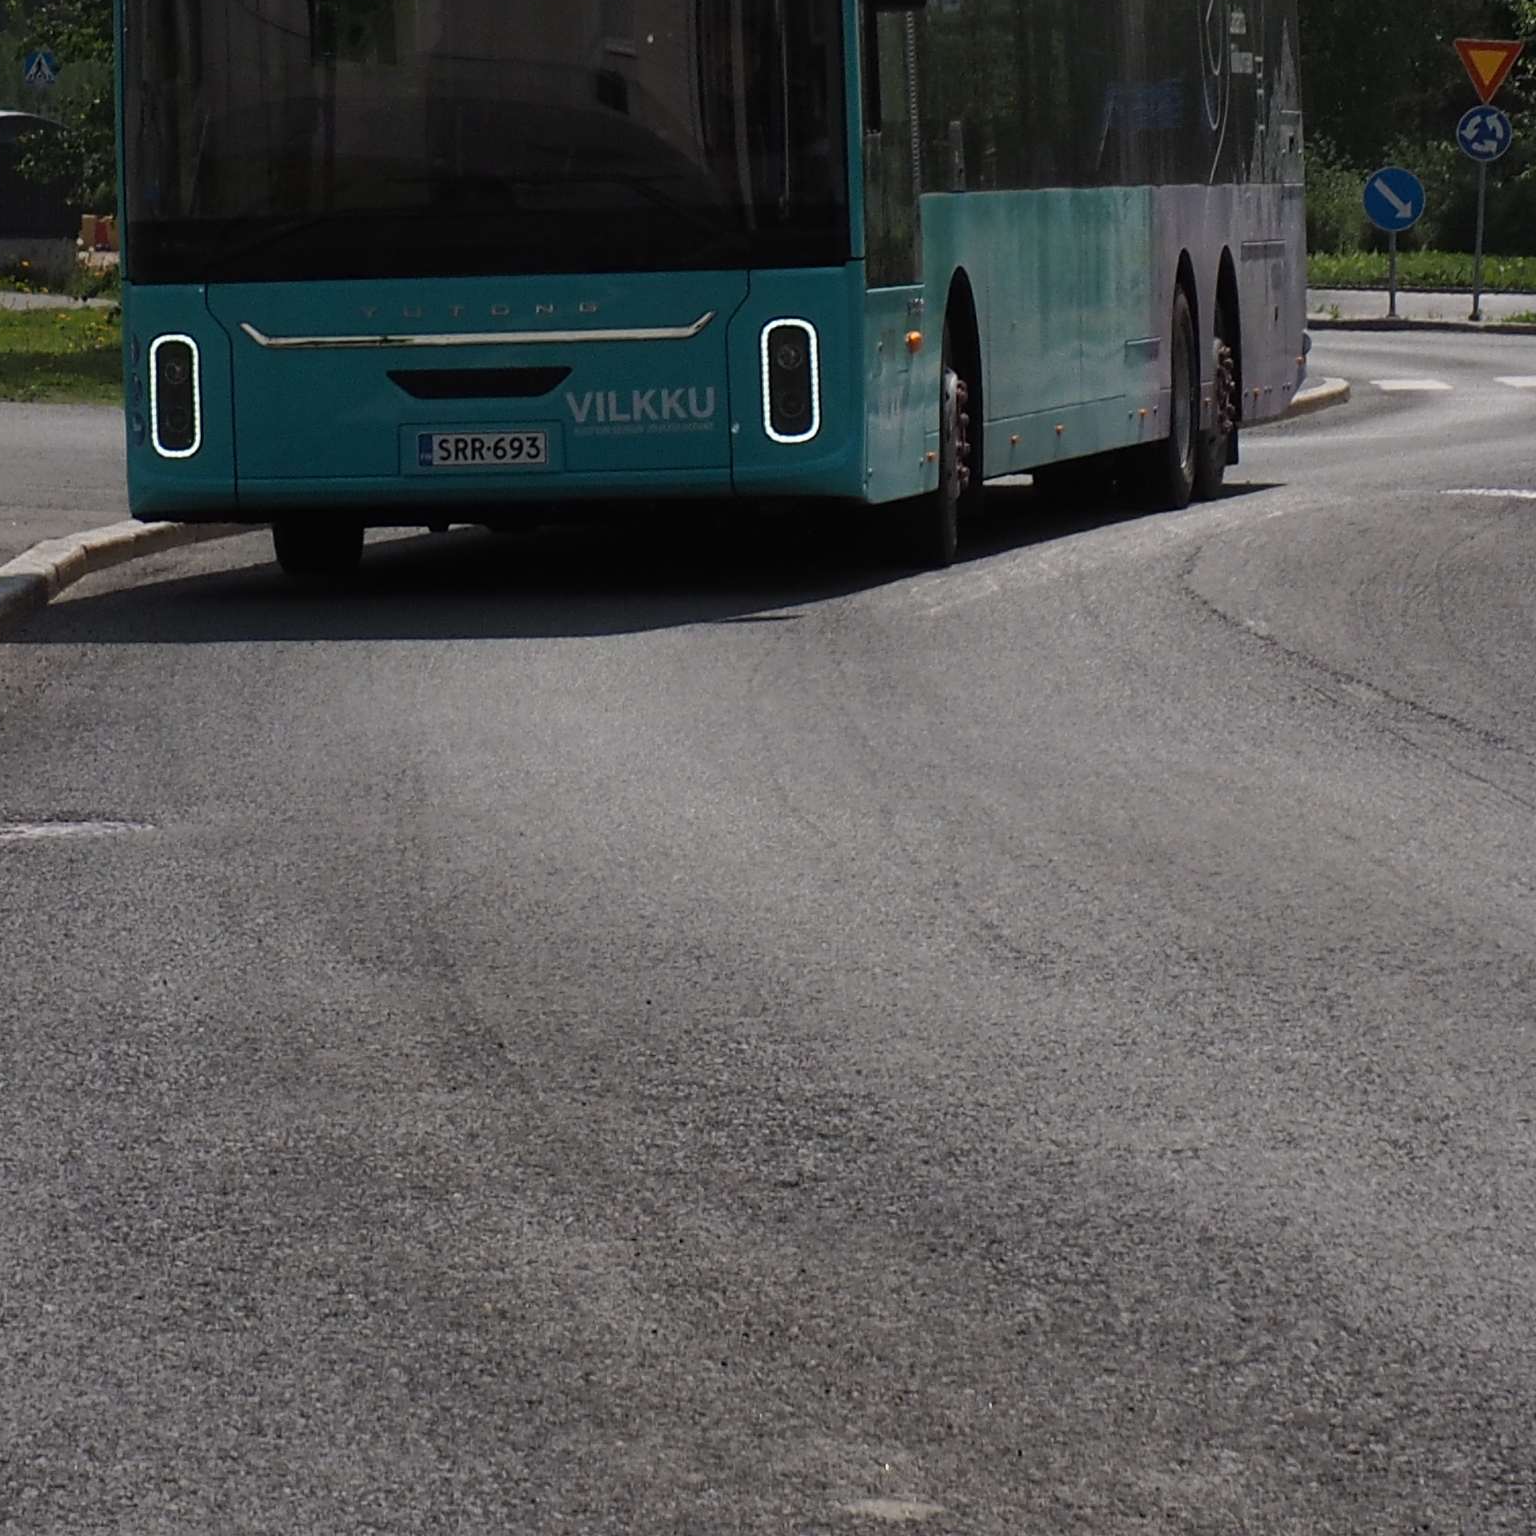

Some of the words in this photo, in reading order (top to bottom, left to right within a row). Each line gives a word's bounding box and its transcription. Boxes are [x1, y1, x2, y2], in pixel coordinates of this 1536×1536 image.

[362, 301, 599, 319] YUTONG
[565, 386, 716, 423] VILKKU
[438, 436, 542, 462] SRR-693
